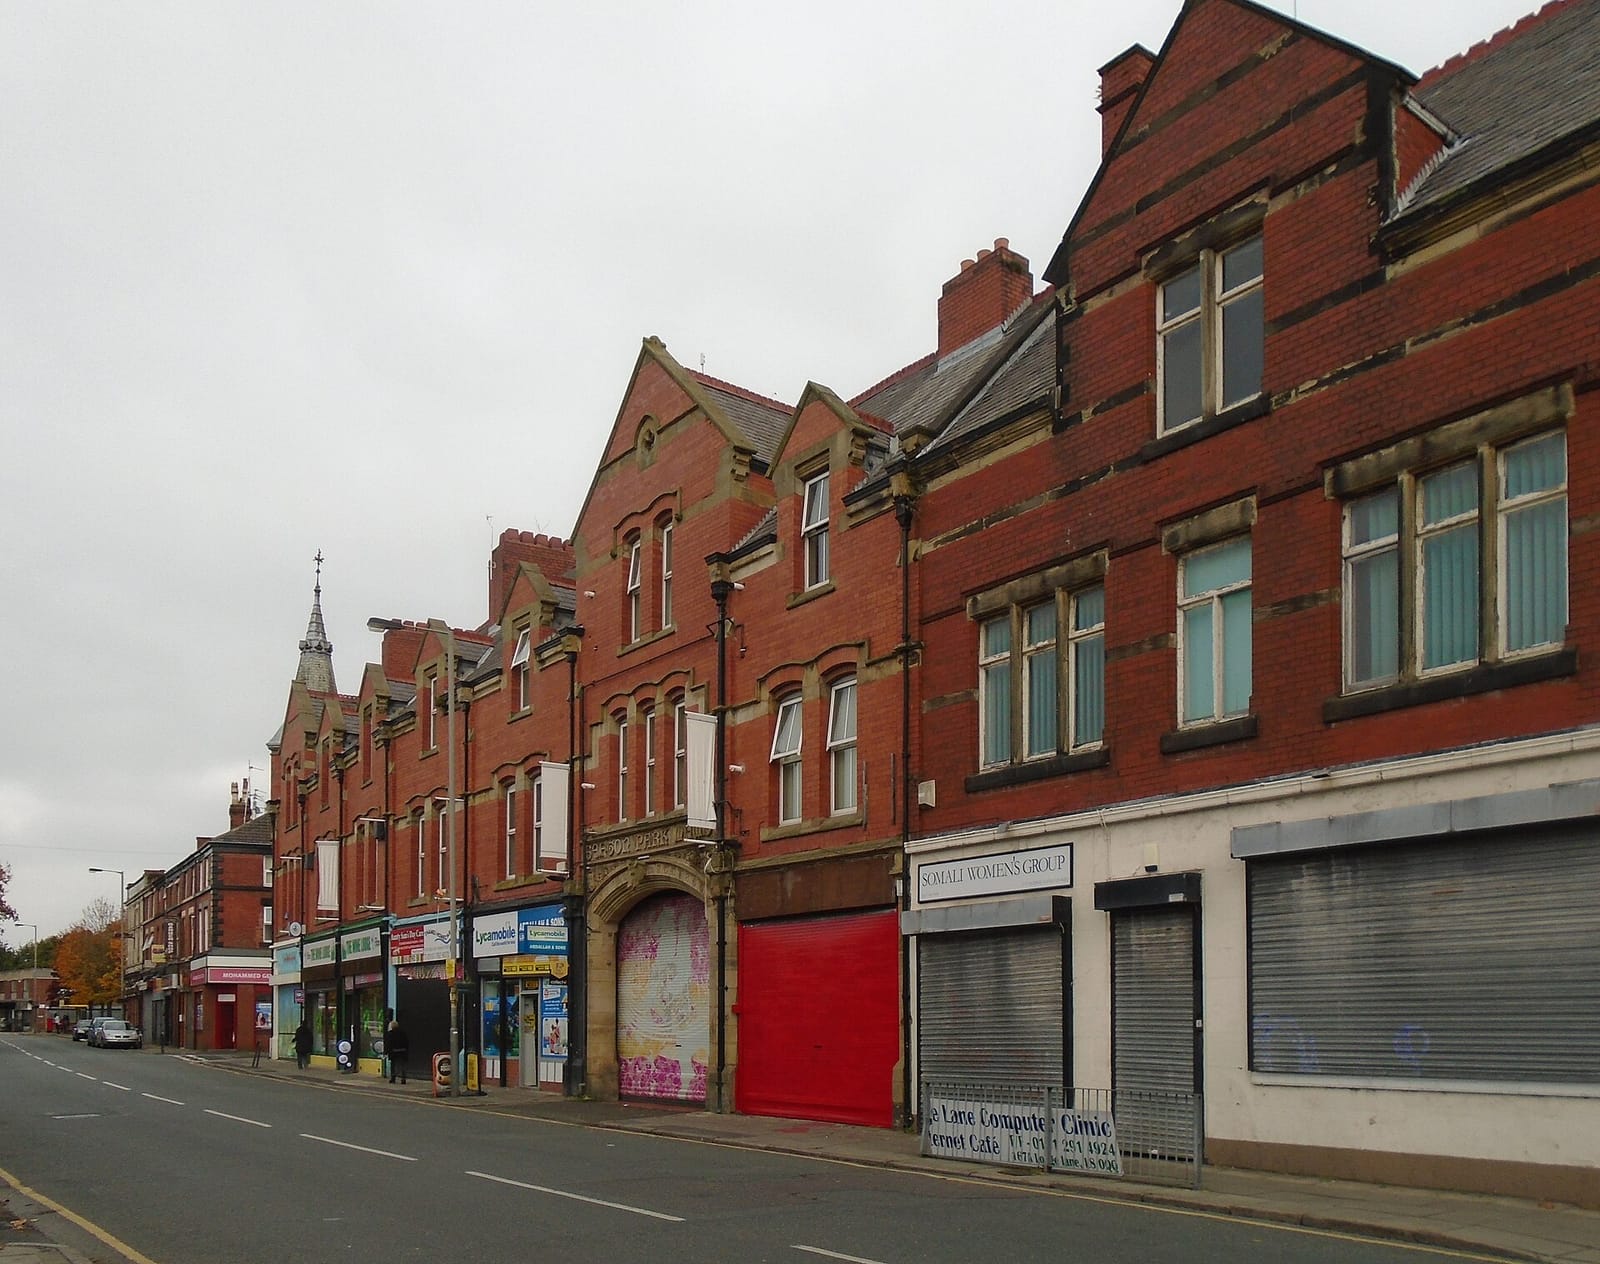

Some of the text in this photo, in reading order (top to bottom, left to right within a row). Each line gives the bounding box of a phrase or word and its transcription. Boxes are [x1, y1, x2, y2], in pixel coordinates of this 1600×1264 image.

[634, 829, 670, 852] PARK
[921, 854, 1066, 887] SOMALI WOMEN'S GROUP
[475, 925, 516, 945] Lycamobile
[529, 929, 565, 938] Lycamobile
[942, 1104, 976, 1126] Lane
[1061, 1113, 1112, 1138] Clinic
[969, 1133, 1001, 1155] Café
[1032, 1136, 1057, 1150] 011
[1062, 1138, 1083, 1153] 291
[1088, 1141, 1116, 1156] 4924
